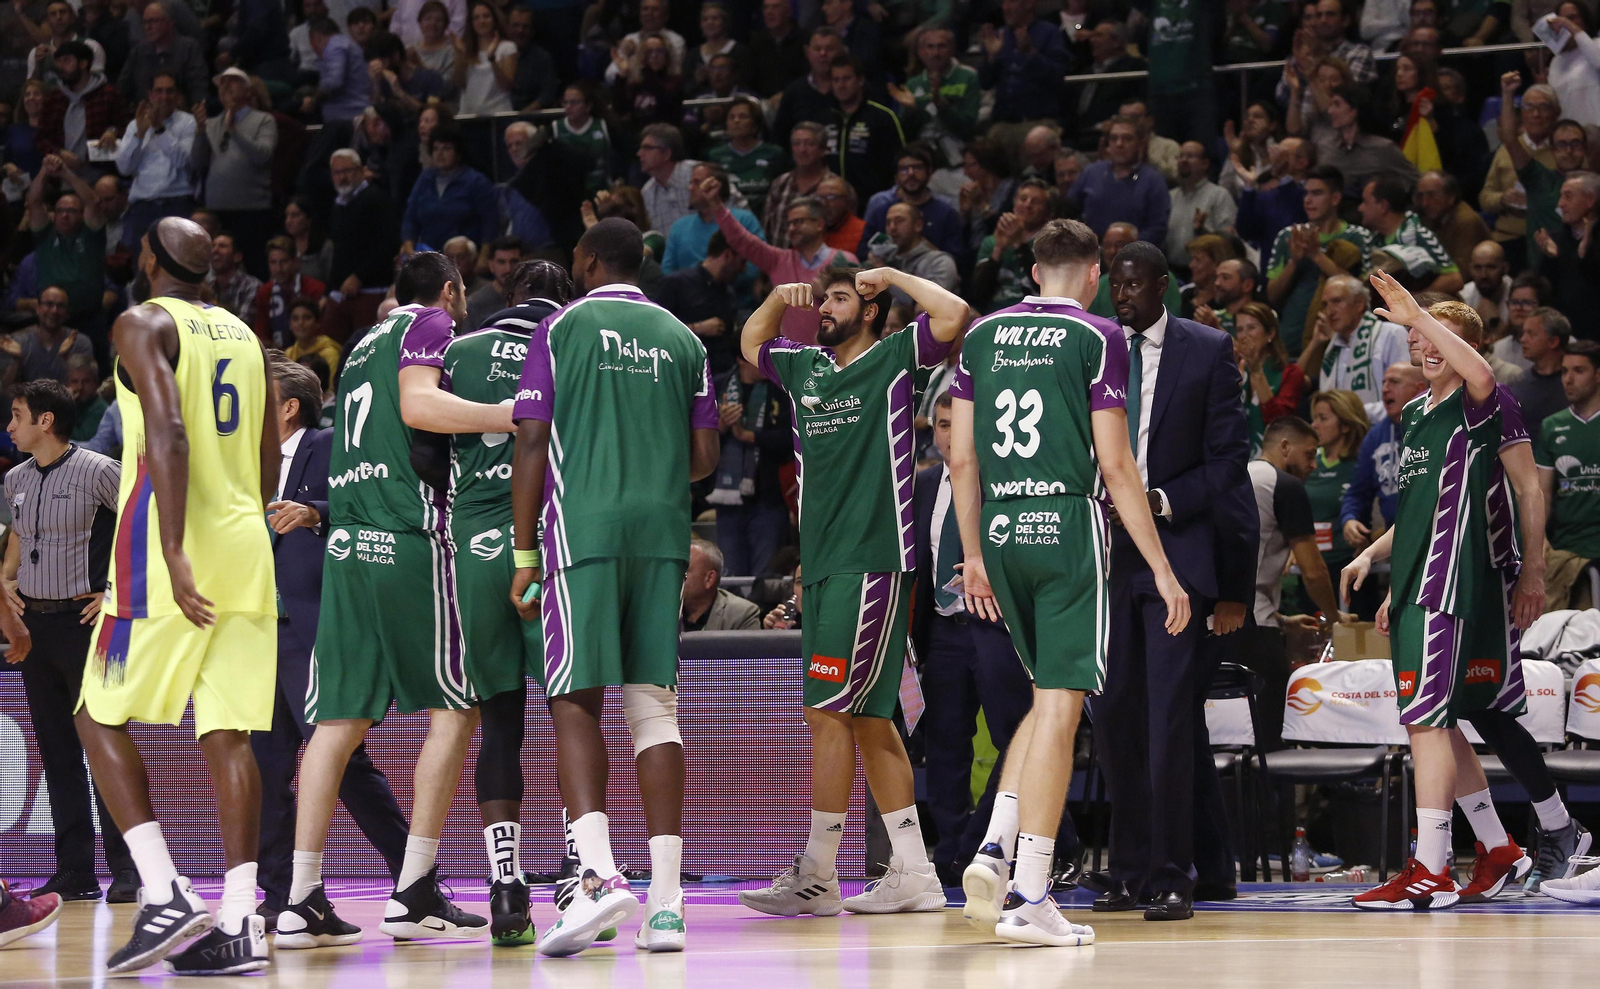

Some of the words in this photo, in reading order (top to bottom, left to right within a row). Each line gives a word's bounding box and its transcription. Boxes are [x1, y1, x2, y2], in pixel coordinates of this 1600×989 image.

[184, 319, 252, 342] SINLETON
[993, 324, 1067, 348] WILTJER
[599, 329, 673, 382] Málaga
[598, 361, 624, 371] Ciudad
[212, 358, 240, 437] 6
[514, 388, 543, 402] rten
[820, 394, 862, 411] Unicaja
[344, 381, 374, 453] 17
[831, 417, 847, 426] DEL
[992, 388, 1044, 459] 33
[990, 477, 1066, 498] worten
[1018, 511, 1061, 524] COSTA
[358, 529, 396, 545] COSTA
[1015, 524, 1035, 534] DEL
[1036, 524, 1061, 535] SOL
[356, 541, 372, 552] DEL
[373, 543, 396, 555] SOL
[1331, 691, 1362, 699] COSTA
[1364, 691, 1381, 699] DEL
[1383, 690, 1398, 698] SO
[1525, 689, 1534, 697] EL
[1537, 688, 1557, 696] SOL
